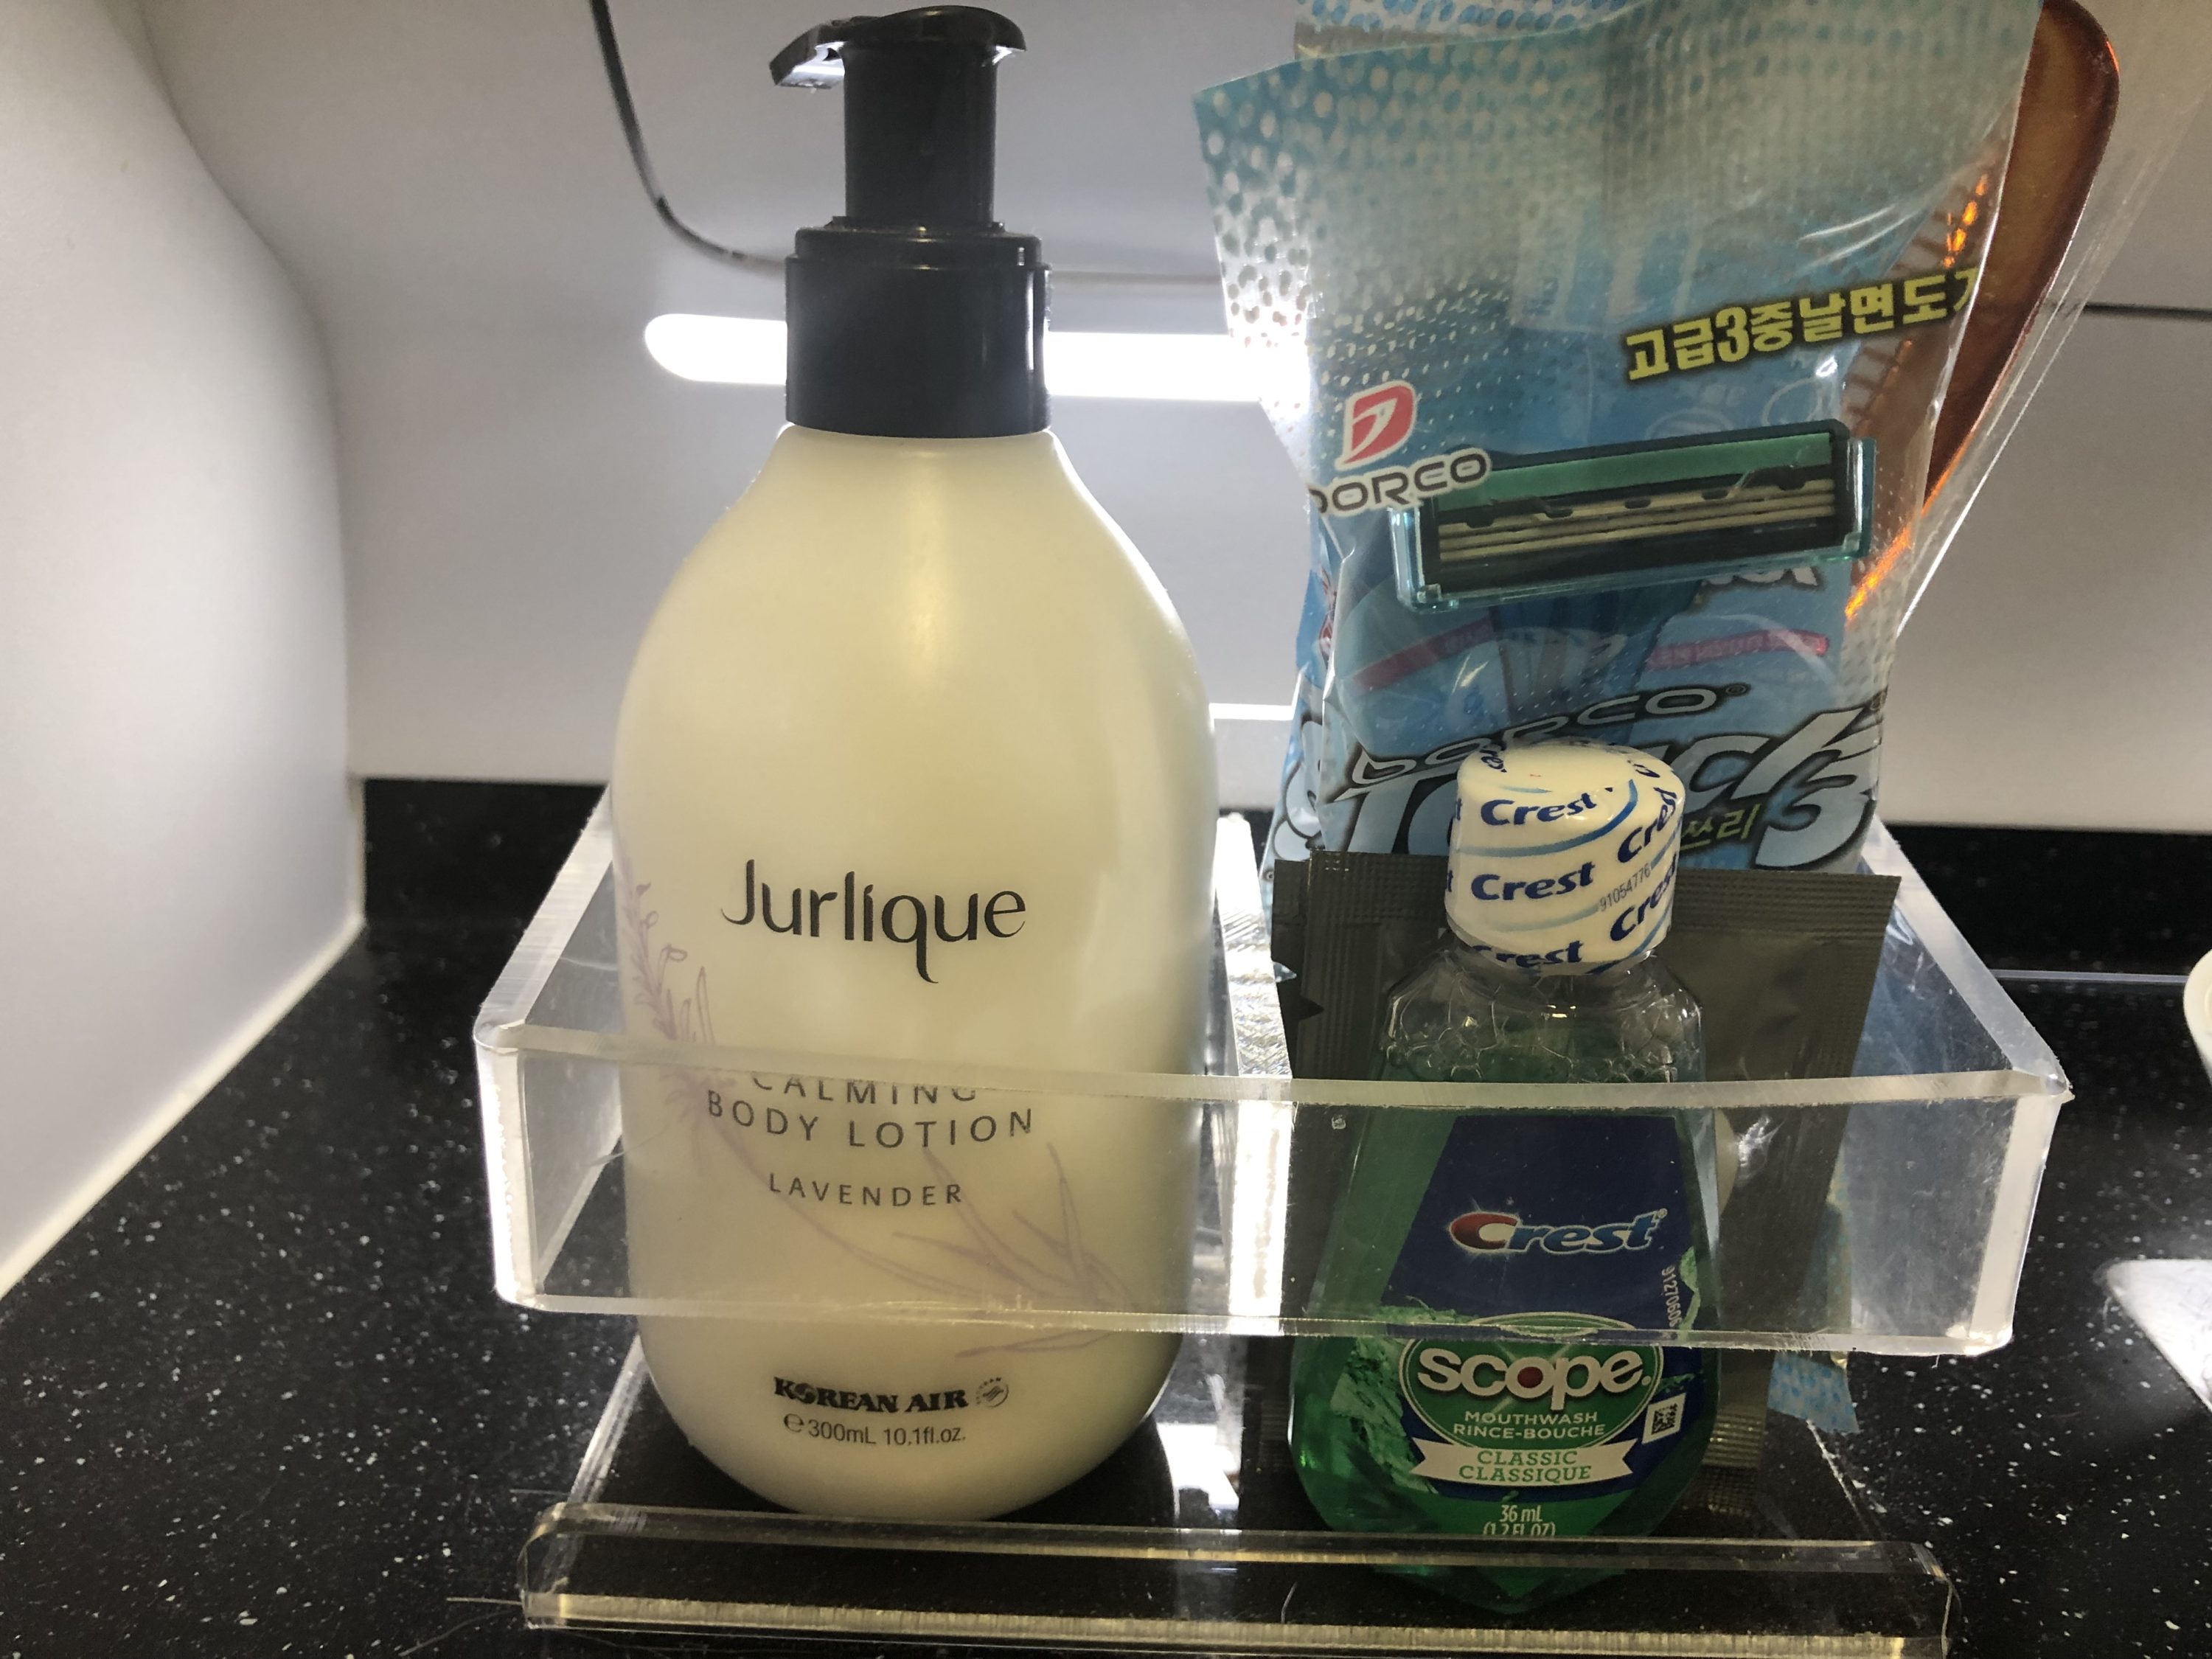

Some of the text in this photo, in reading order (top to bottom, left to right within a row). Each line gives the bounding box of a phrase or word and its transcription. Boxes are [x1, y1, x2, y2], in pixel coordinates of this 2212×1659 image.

[1481, 793, 1597, 826] Crest
[1471, 861, 1596, 900] Crest
[1599, 862, 1652, 912] 91054776
[720, 859, 1026, 984] Jurlique
[1472, 940, 1584, 968] rest
[706, 1089, 1032, 1149] BODY LOTION
[768, 1172, 962, 1207] LAVENDER
[1450, 1211, 1659, 1253] Crest
[774, 1377, 899, 1413] KOREAN
[905, 1389, 969, 1413] AIR
[1453, 1423, 1606, 1439] RINCE-BOUCHE
[1464, 1411, 1598, 1425] MOUTHWASH
[1458, 1464, 1592, 1483] CLASSIQUE
[1478, 1450, 1578, 1466] CLASSIC
[1500, 1505, 1543, 1522] 36 mL
